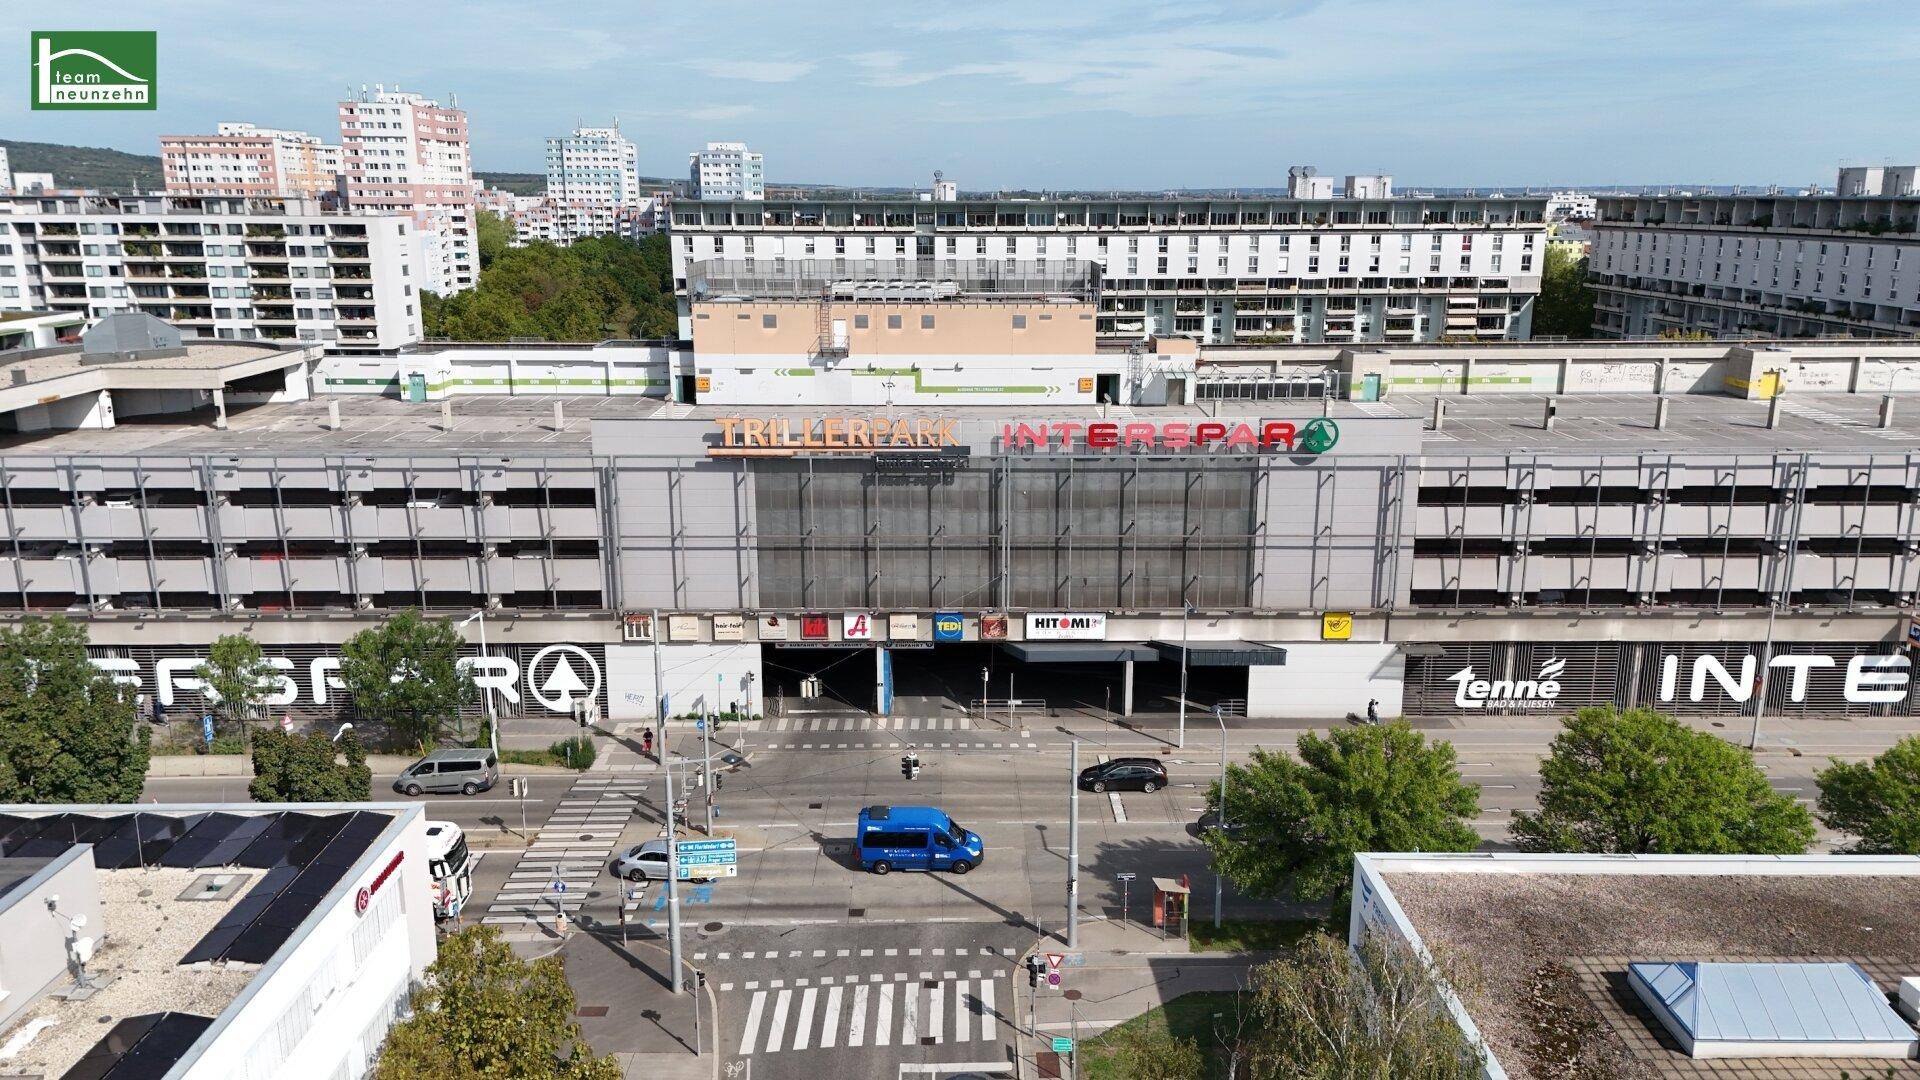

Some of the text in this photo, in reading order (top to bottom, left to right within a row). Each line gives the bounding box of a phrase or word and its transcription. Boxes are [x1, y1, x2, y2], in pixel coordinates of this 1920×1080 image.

[714, 417, 961, 447] TRILLERPARK
[1003, 423, 1296, 448] INTERSPAR
[937, 621, 962, 631] TEDi
[1035, 618, 1090, 629] HITOMI
[1486, 700, 1556, 708] BAD & FLIESEN
[680, 868, 688, 878] P
